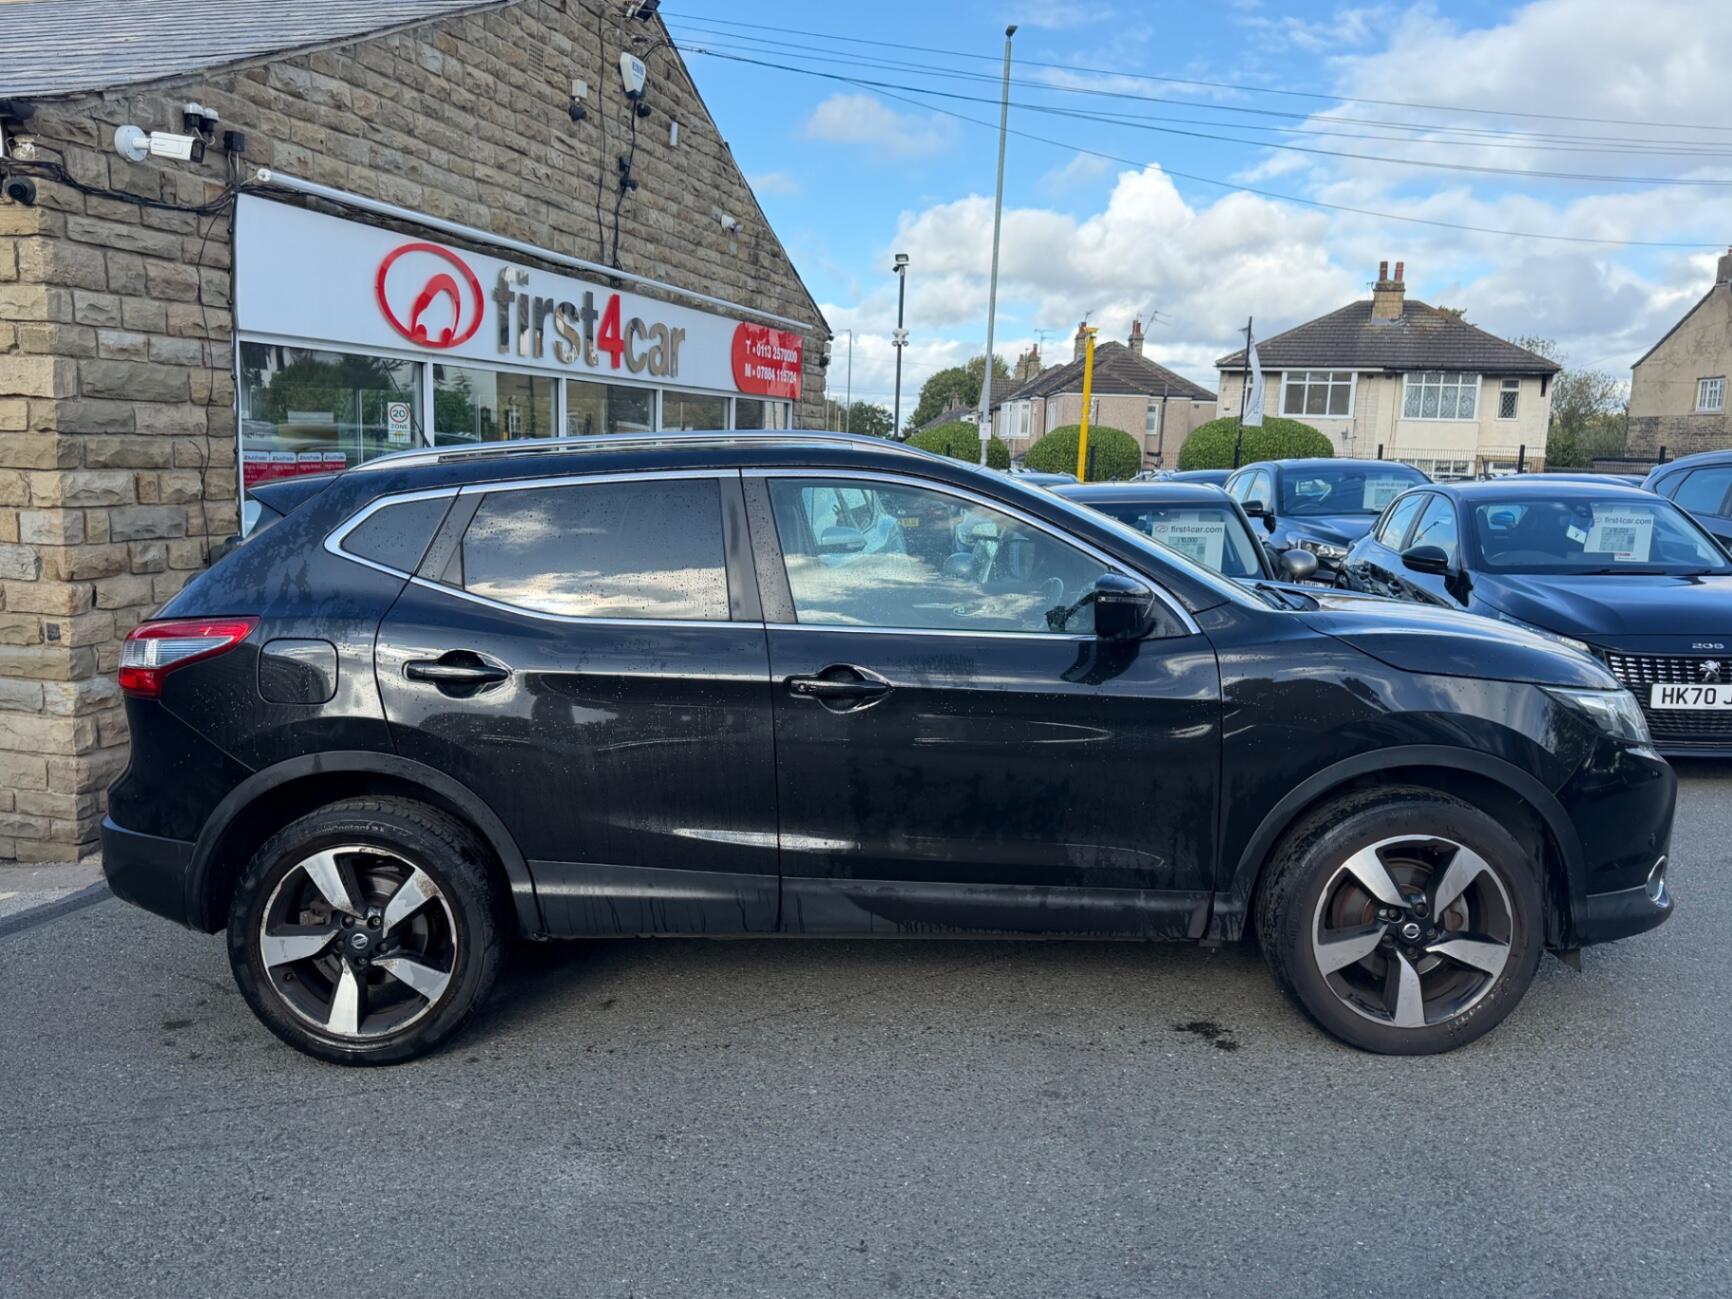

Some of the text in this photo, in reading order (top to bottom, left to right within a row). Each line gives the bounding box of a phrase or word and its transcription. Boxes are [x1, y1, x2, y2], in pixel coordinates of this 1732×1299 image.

[492, 265, 686, 378] first4car
[746, 340, 752, 354] T
[392, 409, 406, 418] 20
[1661, 687, 1717, 705] HK70
